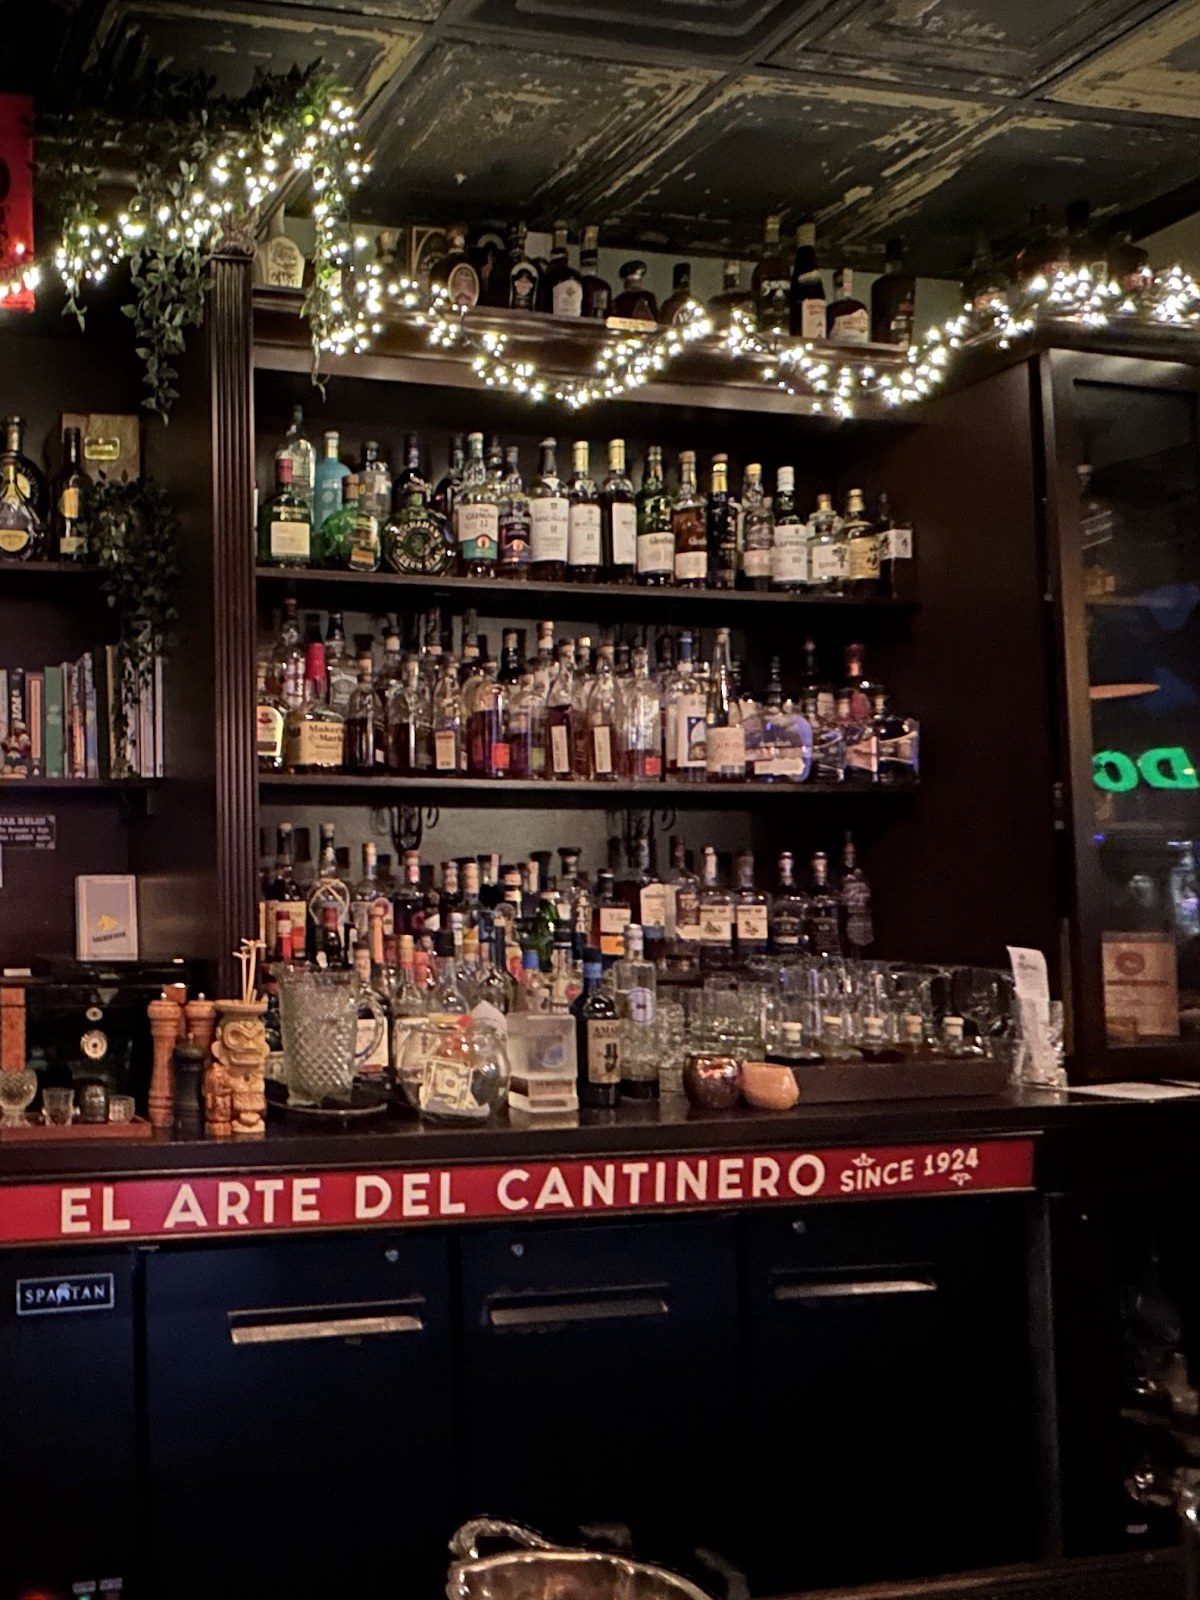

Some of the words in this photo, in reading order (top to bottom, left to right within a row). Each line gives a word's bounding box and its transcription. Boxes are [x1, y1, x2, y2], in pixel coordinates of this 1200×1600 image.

[839, 1159, 915, 1192] SINCE
[922, 1147, 980, 1176] 1924
[60, 1185, 131, 1233] EL
[162, 1177, 322, 1228] ARTE
[354, 1173, 466, 1219] DEL
[496, 1154, 826, 1211] CANTINERO
[24, 1282, 106, 1306] SPARTAN
